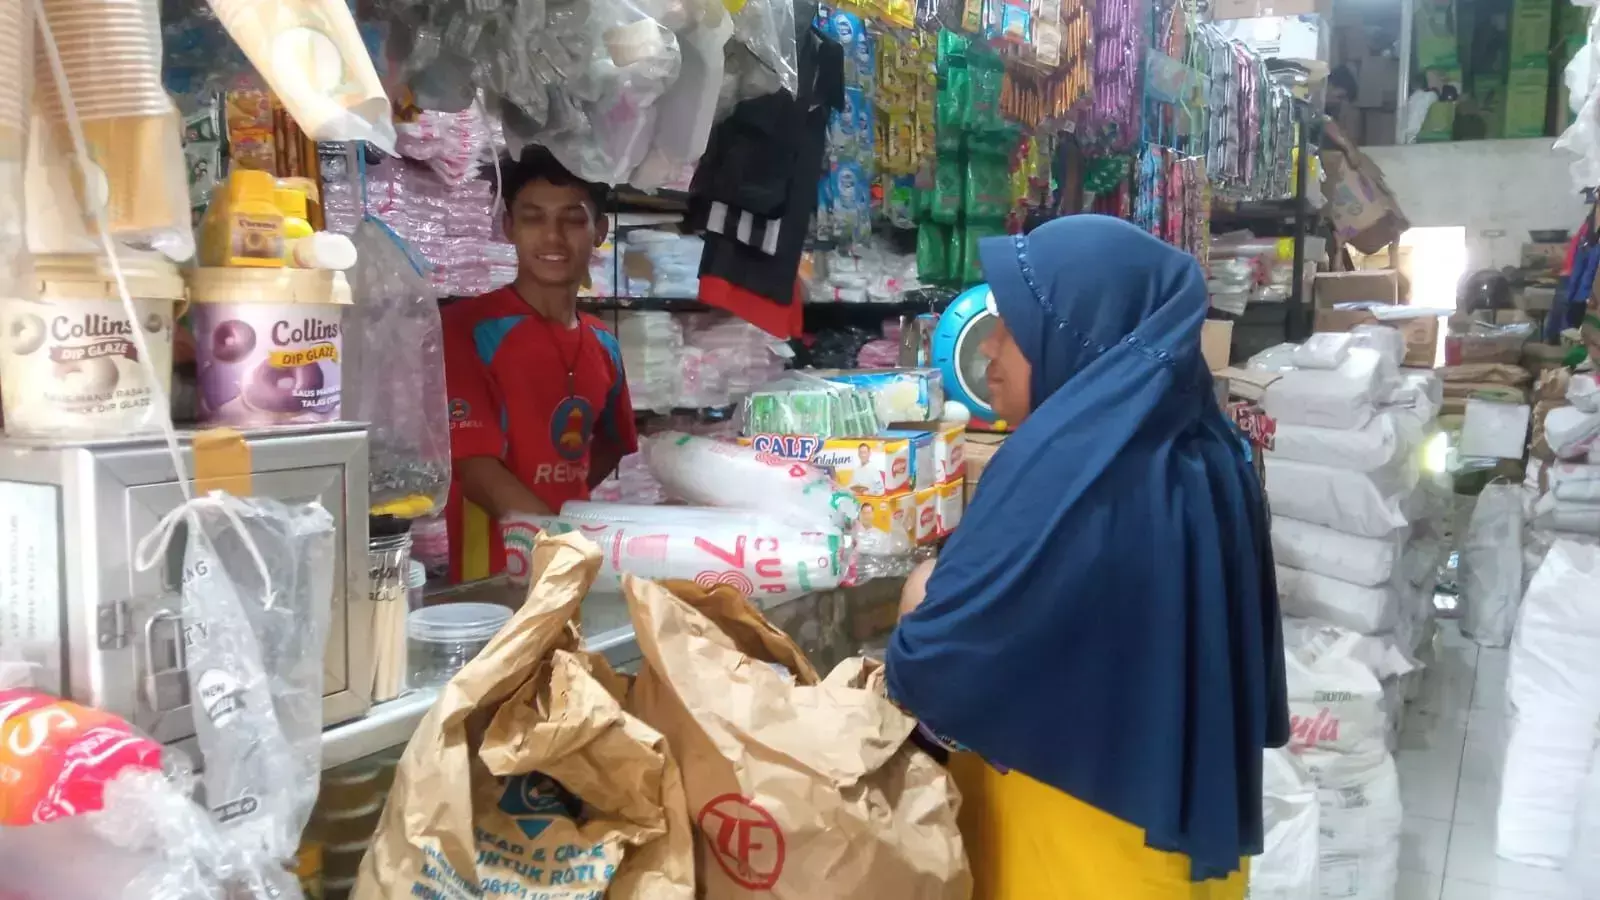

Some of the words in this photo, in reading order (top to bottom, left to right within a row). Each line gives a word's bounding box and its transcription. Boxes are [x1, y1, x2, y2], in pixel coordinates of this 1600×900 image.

[51, 313, 132, 341] Collins
[271, 318, 338, 346] Collins
[61, 347, 86, 360] DIP
[87, 342, 129, 357] GLAZE
[282, 353, 304, 365] DIP
[306, 346, 335, 361] GLAZE
[754, 536, 788, 595] CUP
